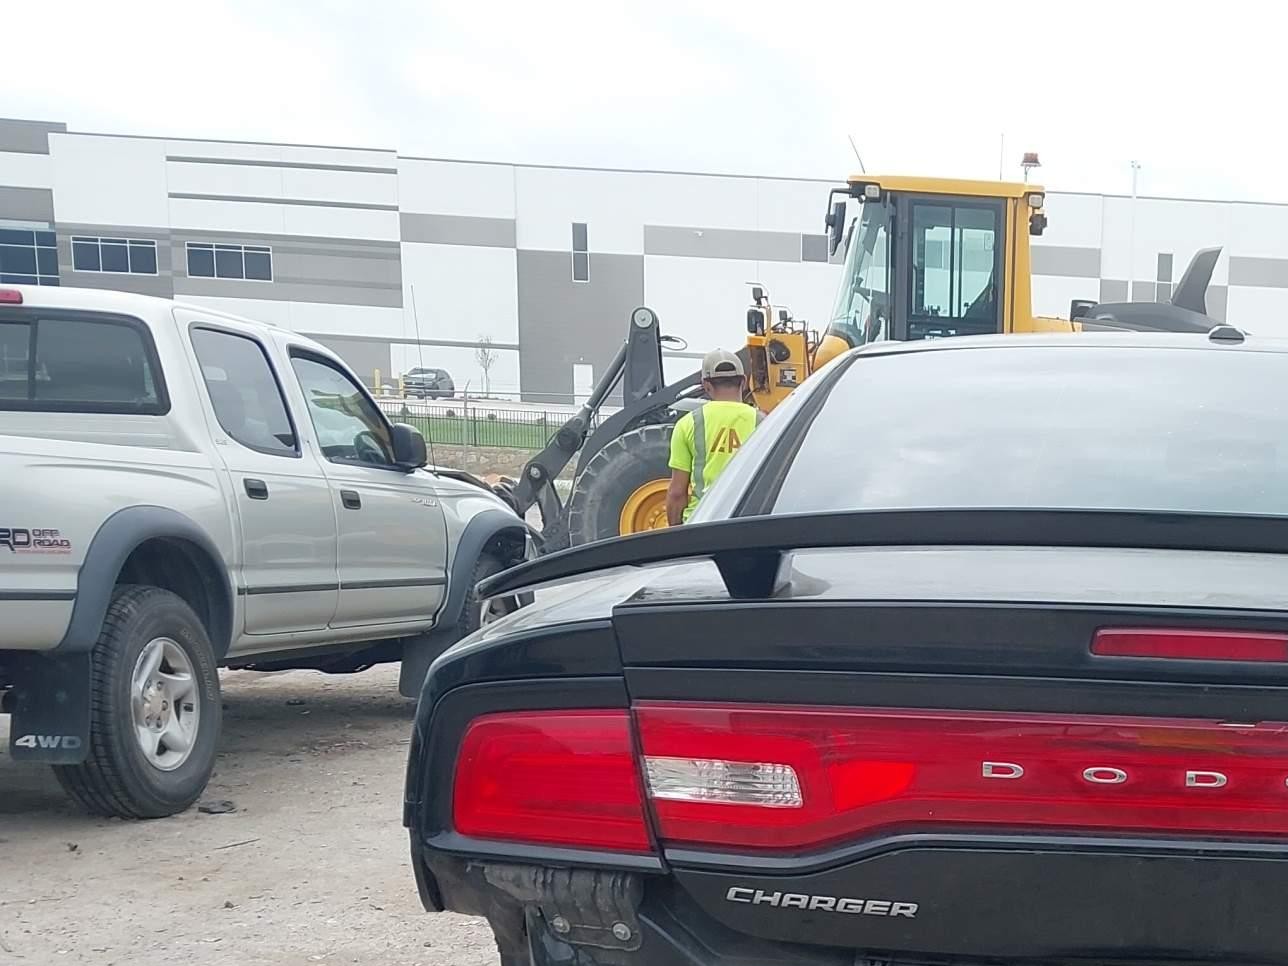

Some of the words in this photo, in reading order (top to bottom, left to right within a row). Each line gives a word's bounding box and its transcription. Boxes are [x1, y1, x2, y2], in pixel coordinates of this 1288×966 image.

[32, 528, 60, 536] OFF
[33, 539, 71, 547] ROAD
[15, 735, 81, 748] 4WD
[726, 887, 919, 917] CHARGER
